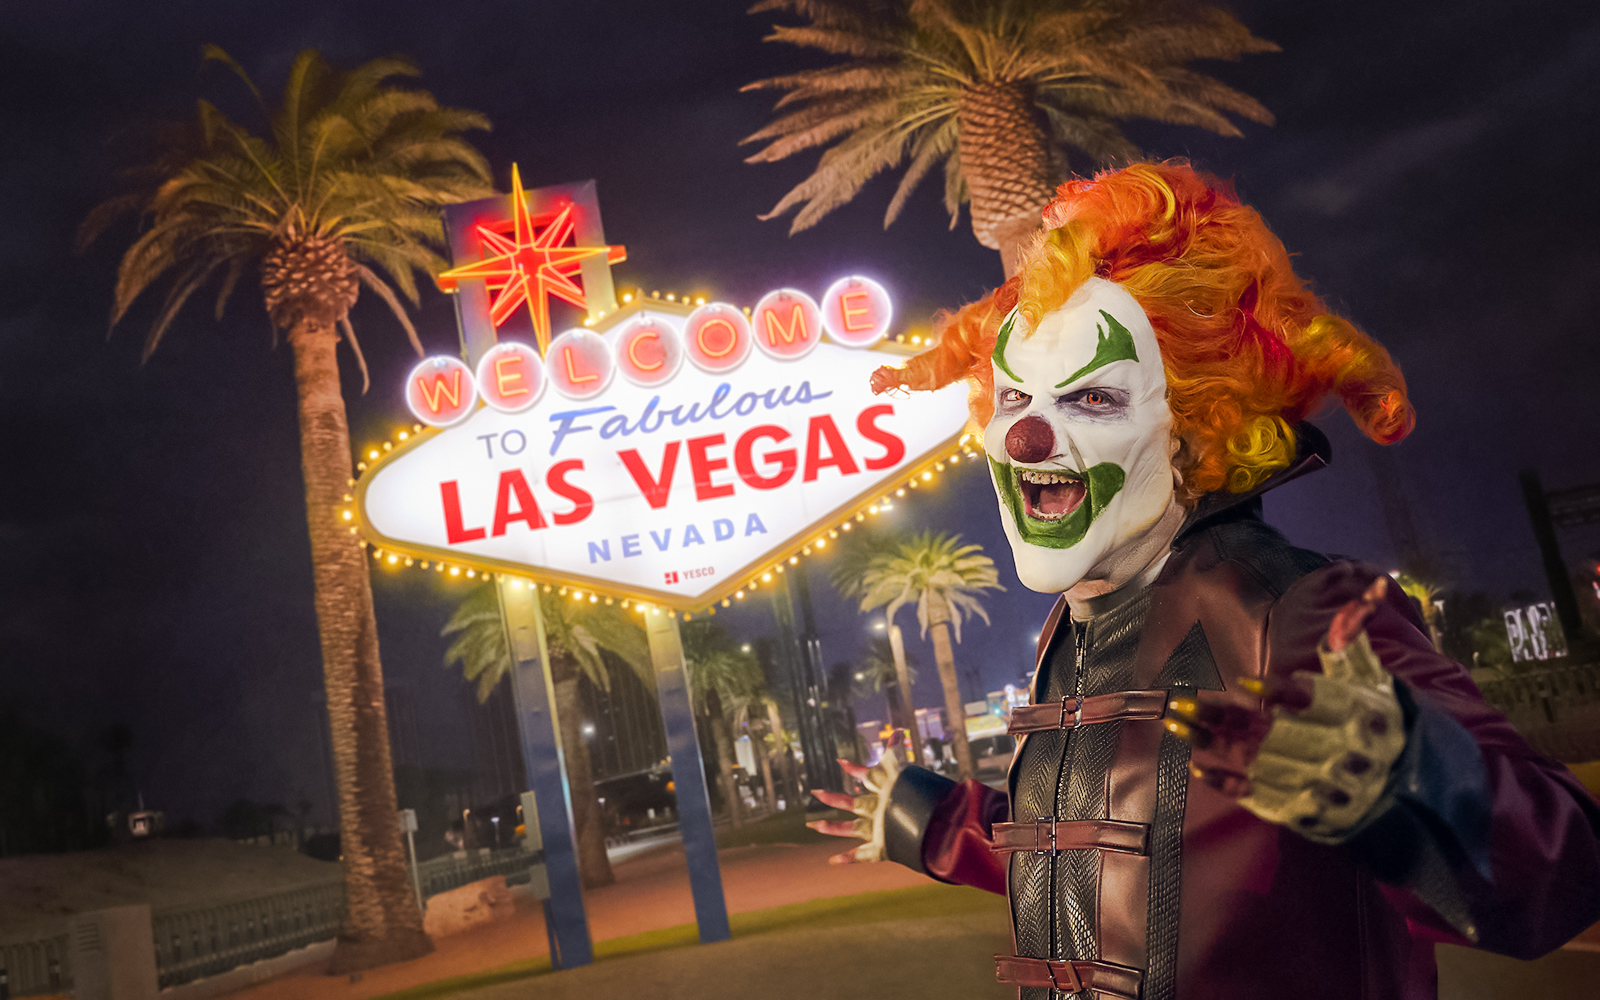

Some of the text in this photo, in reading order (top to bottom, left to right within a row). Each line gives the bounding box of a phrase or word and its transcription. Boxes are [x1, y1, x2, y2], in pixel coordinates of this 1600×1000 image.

[418, 291, 875, 413] WELCOME
[477, 382, 832, 459] TO Fabulous
[440, 404, 906, 545] LAS VEGAS
[587, 513, 767, 564] NEVADA
[683, 567, 715, 579] YESCO
